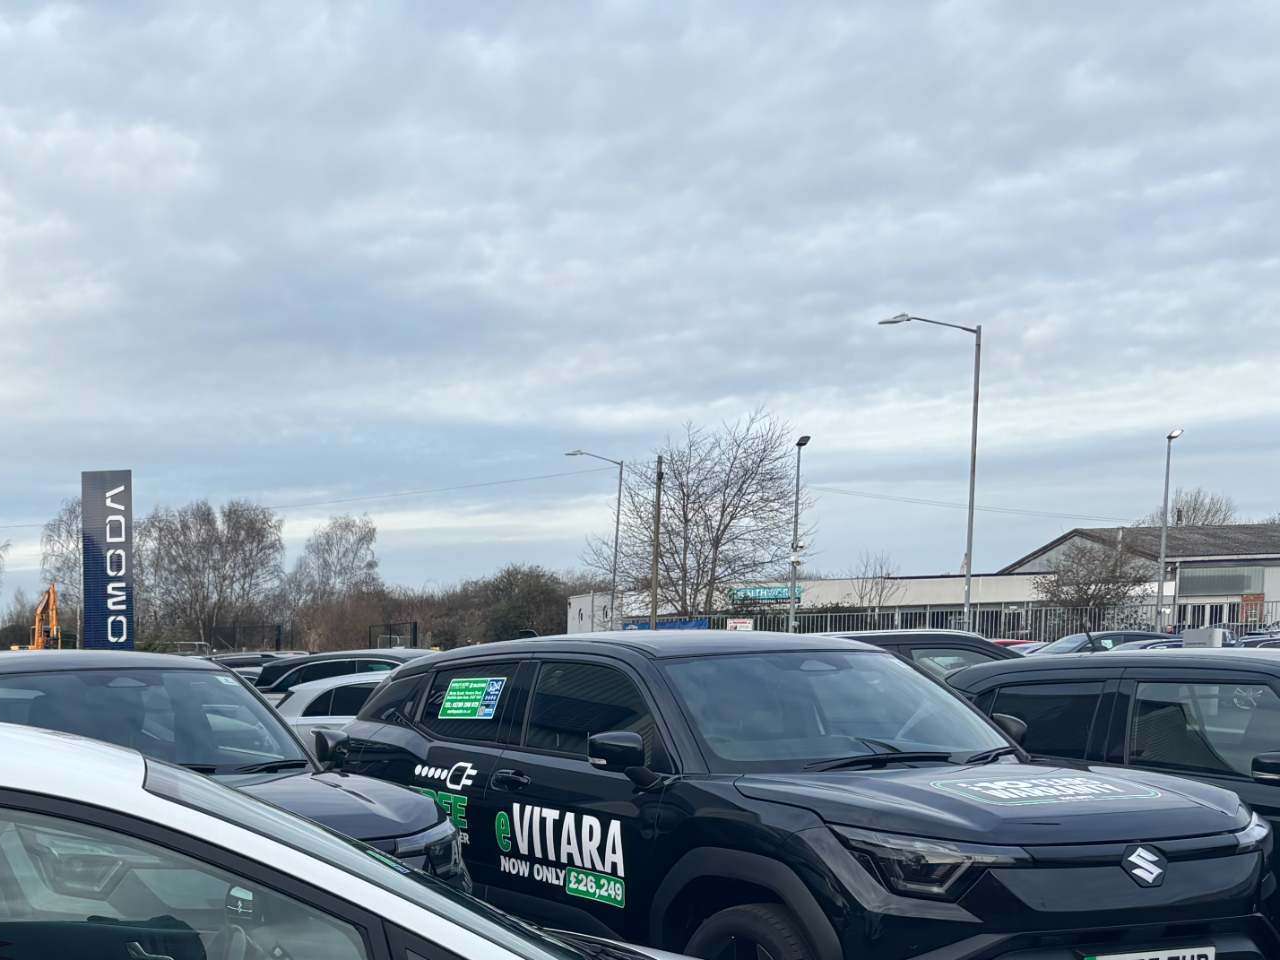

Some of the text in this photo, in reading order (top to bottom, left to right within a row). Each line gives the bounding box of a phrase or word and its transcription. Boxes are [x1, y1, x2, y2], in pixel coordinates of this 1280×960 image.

[105, 485, 128, 643] OMODA
[500, 855, 530, 878] NOW
[533, 863, 566, 887] ONLY
[569, 871, 622, 901] £26,249
